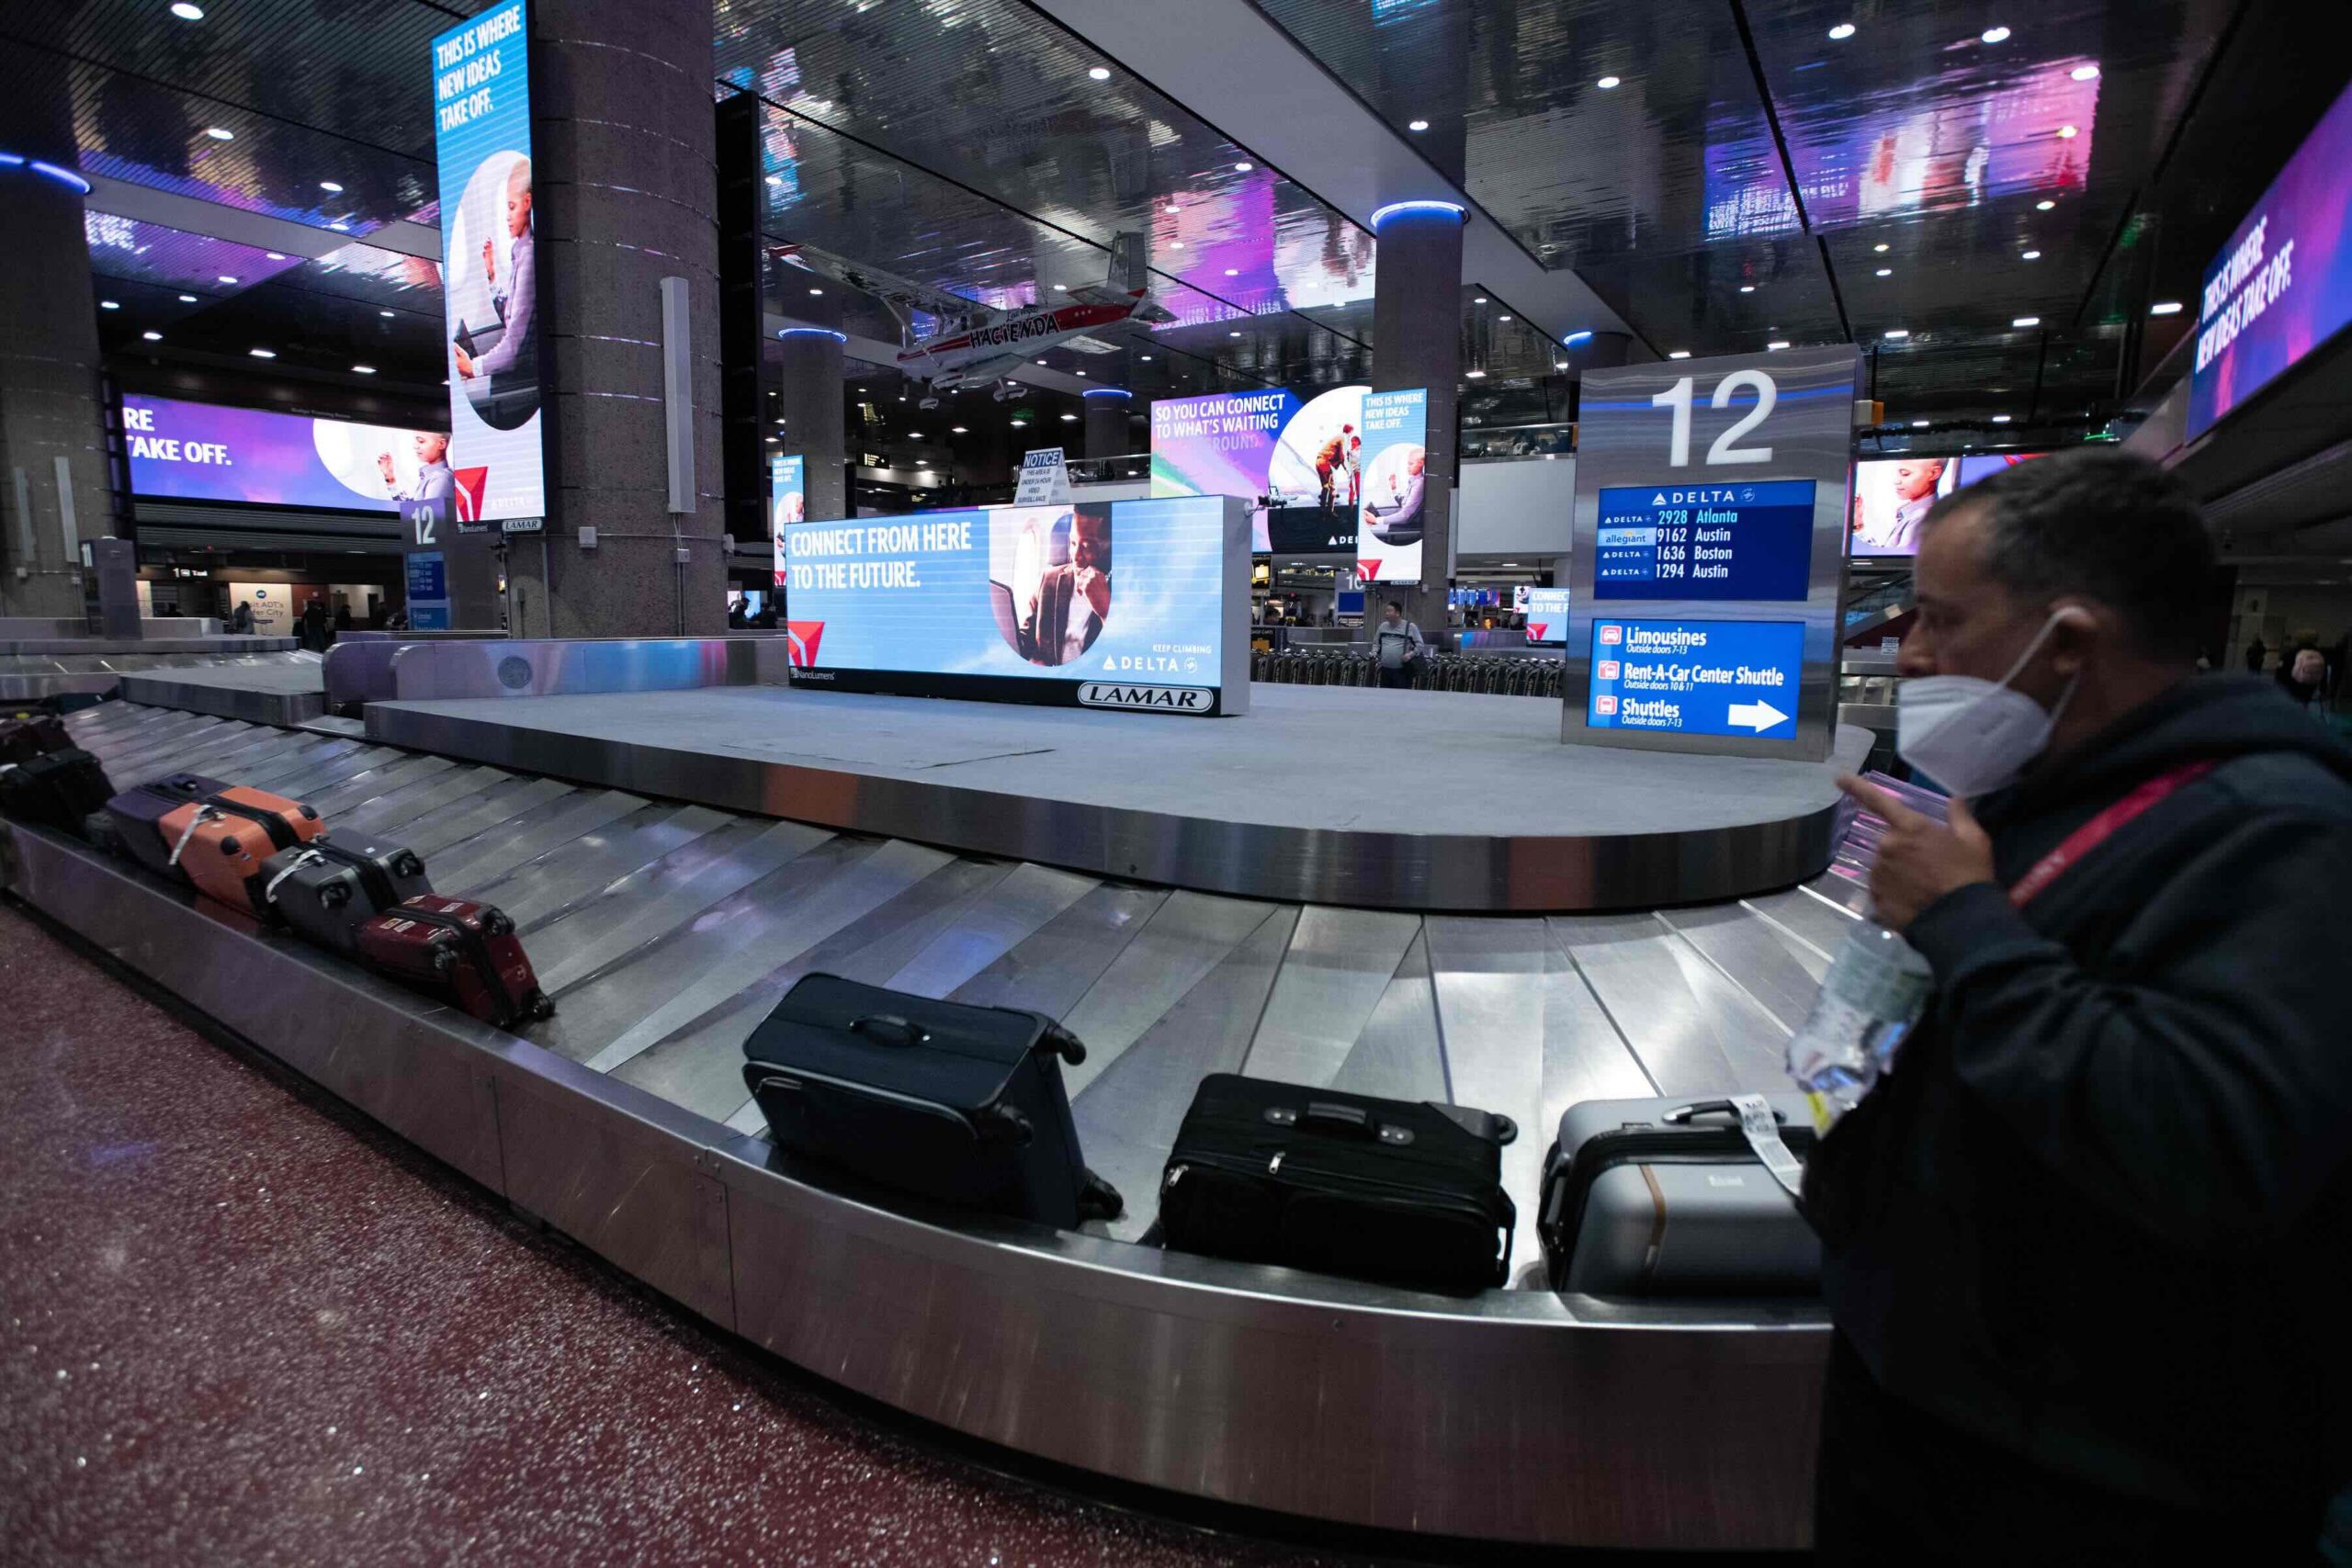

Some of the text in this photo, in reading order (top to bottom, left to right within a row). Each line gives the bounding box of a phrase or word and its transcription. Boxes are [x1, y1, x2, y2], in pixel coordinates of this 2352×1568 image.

[436, 5, 521, 70] THIS IS WHERE
[438, 49, 502, 101] NEW IDEAS
[439, 87, 493, 132] TAKE OFF.
[1156, 393, 1285, 422] SO YOU CAN CONNECT
[1366, 392, 1423, 408] THIS IS WHERE
[1385, 406, 1409, 418] IDEAS
[1652, 369, 1777, 467] 12
[1156, 412, 1278, 438] TO WHAT'S WAITING
[1366, 420, 1385, 430] TAKE
[184, 441, 232, 465] OFF.
[1023, 452, 1059, 467] NOTICE
[1673, 491, 1735, 503] DELTA
[1657, 510, 1688, 525] 2928
[1696, 508, 1737, 524] Atlanta
[412, 505, 435, 545] 12
[505, 522, 537, 530] LAMAR
[791, 522, 972, 557] CONNECT FROM HERE
[1605, 528, 1731, 544] allegiant 9162 Austin
[1657, 546, 1685, 560] 1636
[1694, 546, 1733, 559] Boston
[791, 560, 921, 589] TO THE FUTURE.
[1656, 564, 1685, 578] 1294
[1692, 563, 1728, 578] Austin
[1532, 591, 1567, 602] CONNEC
[1626, 626, 1707, 646] Limousines
[1153, 644, 1212, 654] KEEP CLIMBING
[1626, 645, 1688, 654] Outside doors 7-13
[1121, 656, 1179, 672] DELTA
[1624, 663, 1784, 686] Rent-A-Car Center Shuttle
[1623, 680, 1650, 689] Outside
[1650, 681, 1669, 690] doors
[1686, 682, 1693, 691] 11
[1090, 686, 1197, 707] LAMAR
[1623, 698, 1680, 718] Shuttles
[1622, 715, 1682, 727] Outside doors 7-13
